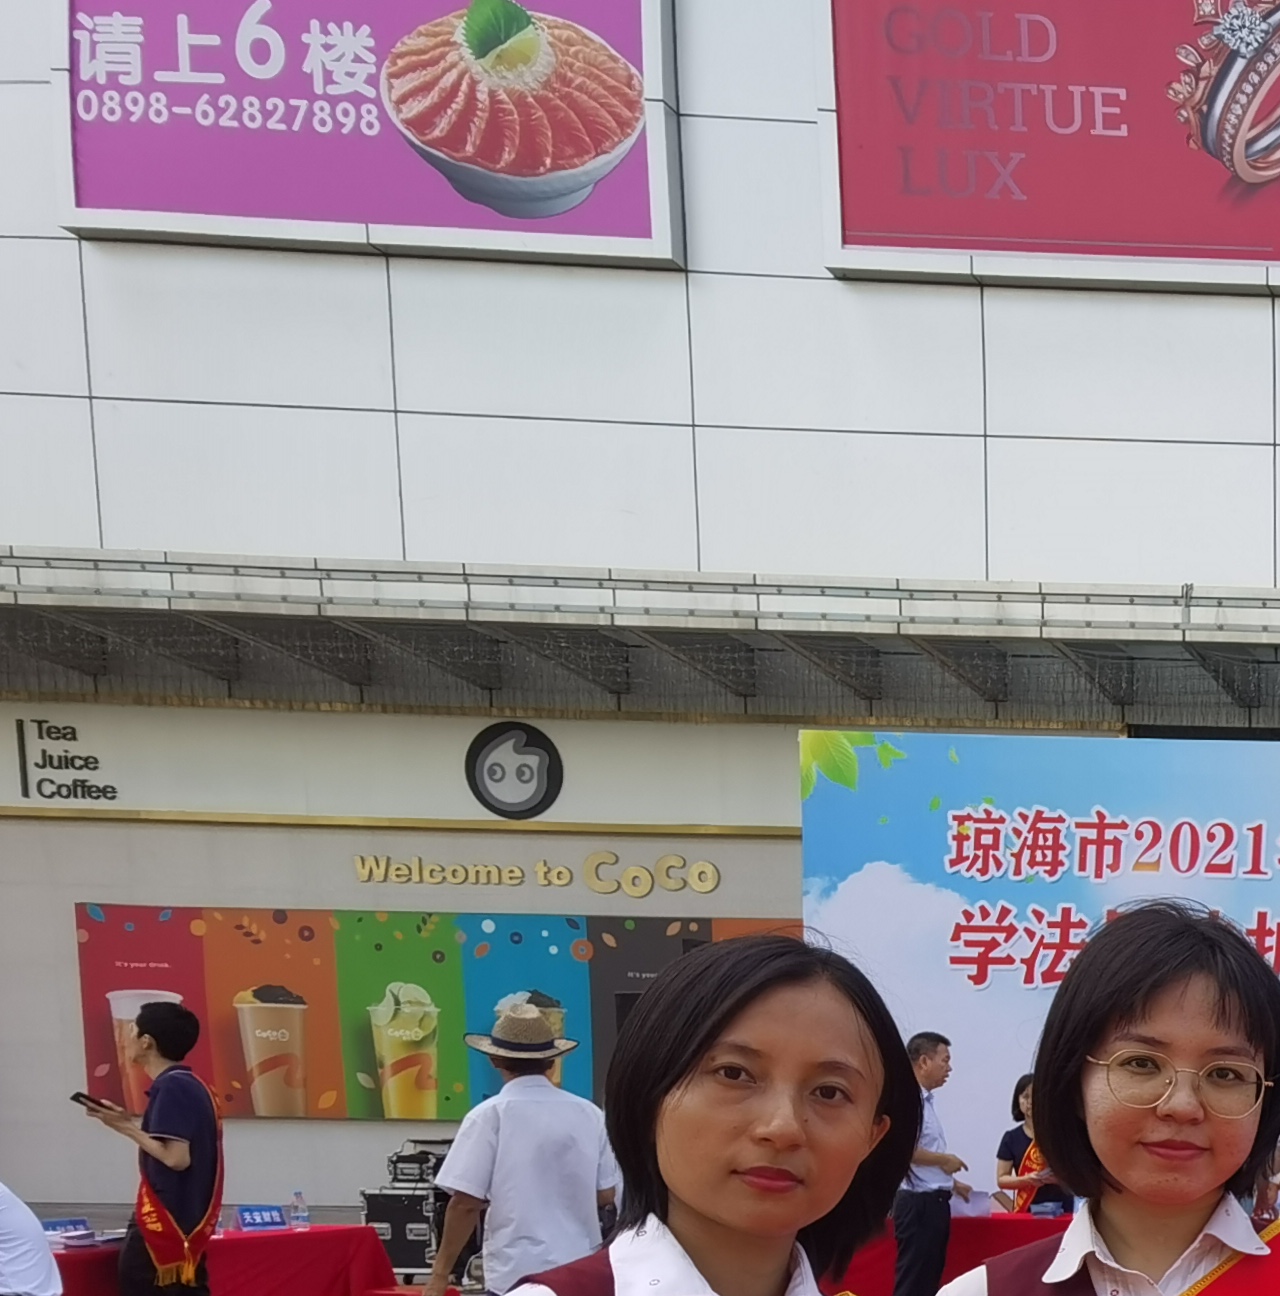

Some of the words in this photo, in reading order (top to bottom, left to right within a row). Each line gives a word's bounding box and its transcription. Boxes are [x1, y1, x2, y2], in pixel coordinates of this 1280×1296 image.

[73, 0, 377, 99] 请上6楼
[885, 8, 1057, 63] GOLD
[76, 90, 380, 136] 0898-62827898
[888, 75, 1128, 137] VIRTUE
[899, 145, 1028, 201] LUX
[30, 719, 78, 741] Tea
[34, 748, 99, 771] Juice
[36, 778, 118, 800] Coffee
[354, 855, 524, 887] Welcome
[534, 857, 573, 887] to
[583, 851, 720, 898] CoCo
